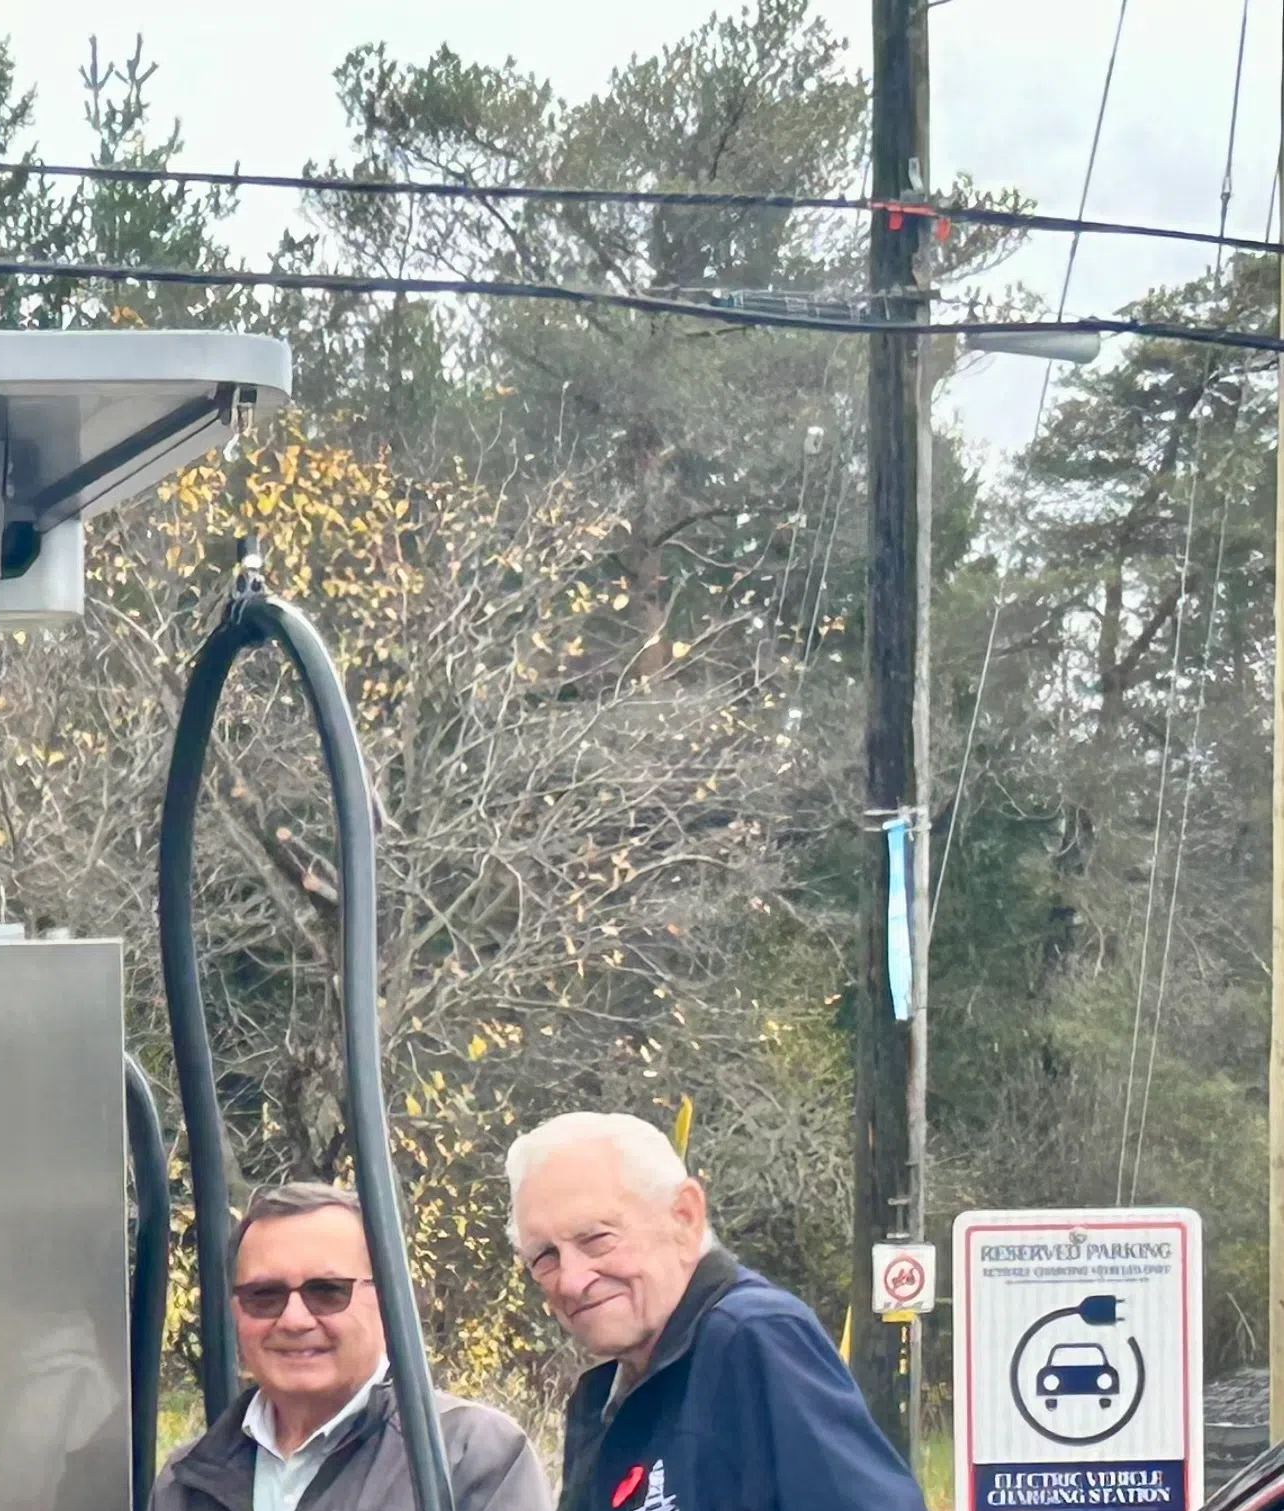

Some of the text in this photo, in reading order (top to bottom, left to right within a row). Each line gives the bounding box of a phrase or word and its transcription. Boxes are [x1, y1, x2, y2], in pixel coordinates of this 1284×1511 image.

[981, 1242, 1172, 1262] RESERVED PARKING
[994, 1470, 1163, 1489] ELECTRIC VEHICLE
[987, 1487, 1171, 1506] CHARGING STATION
